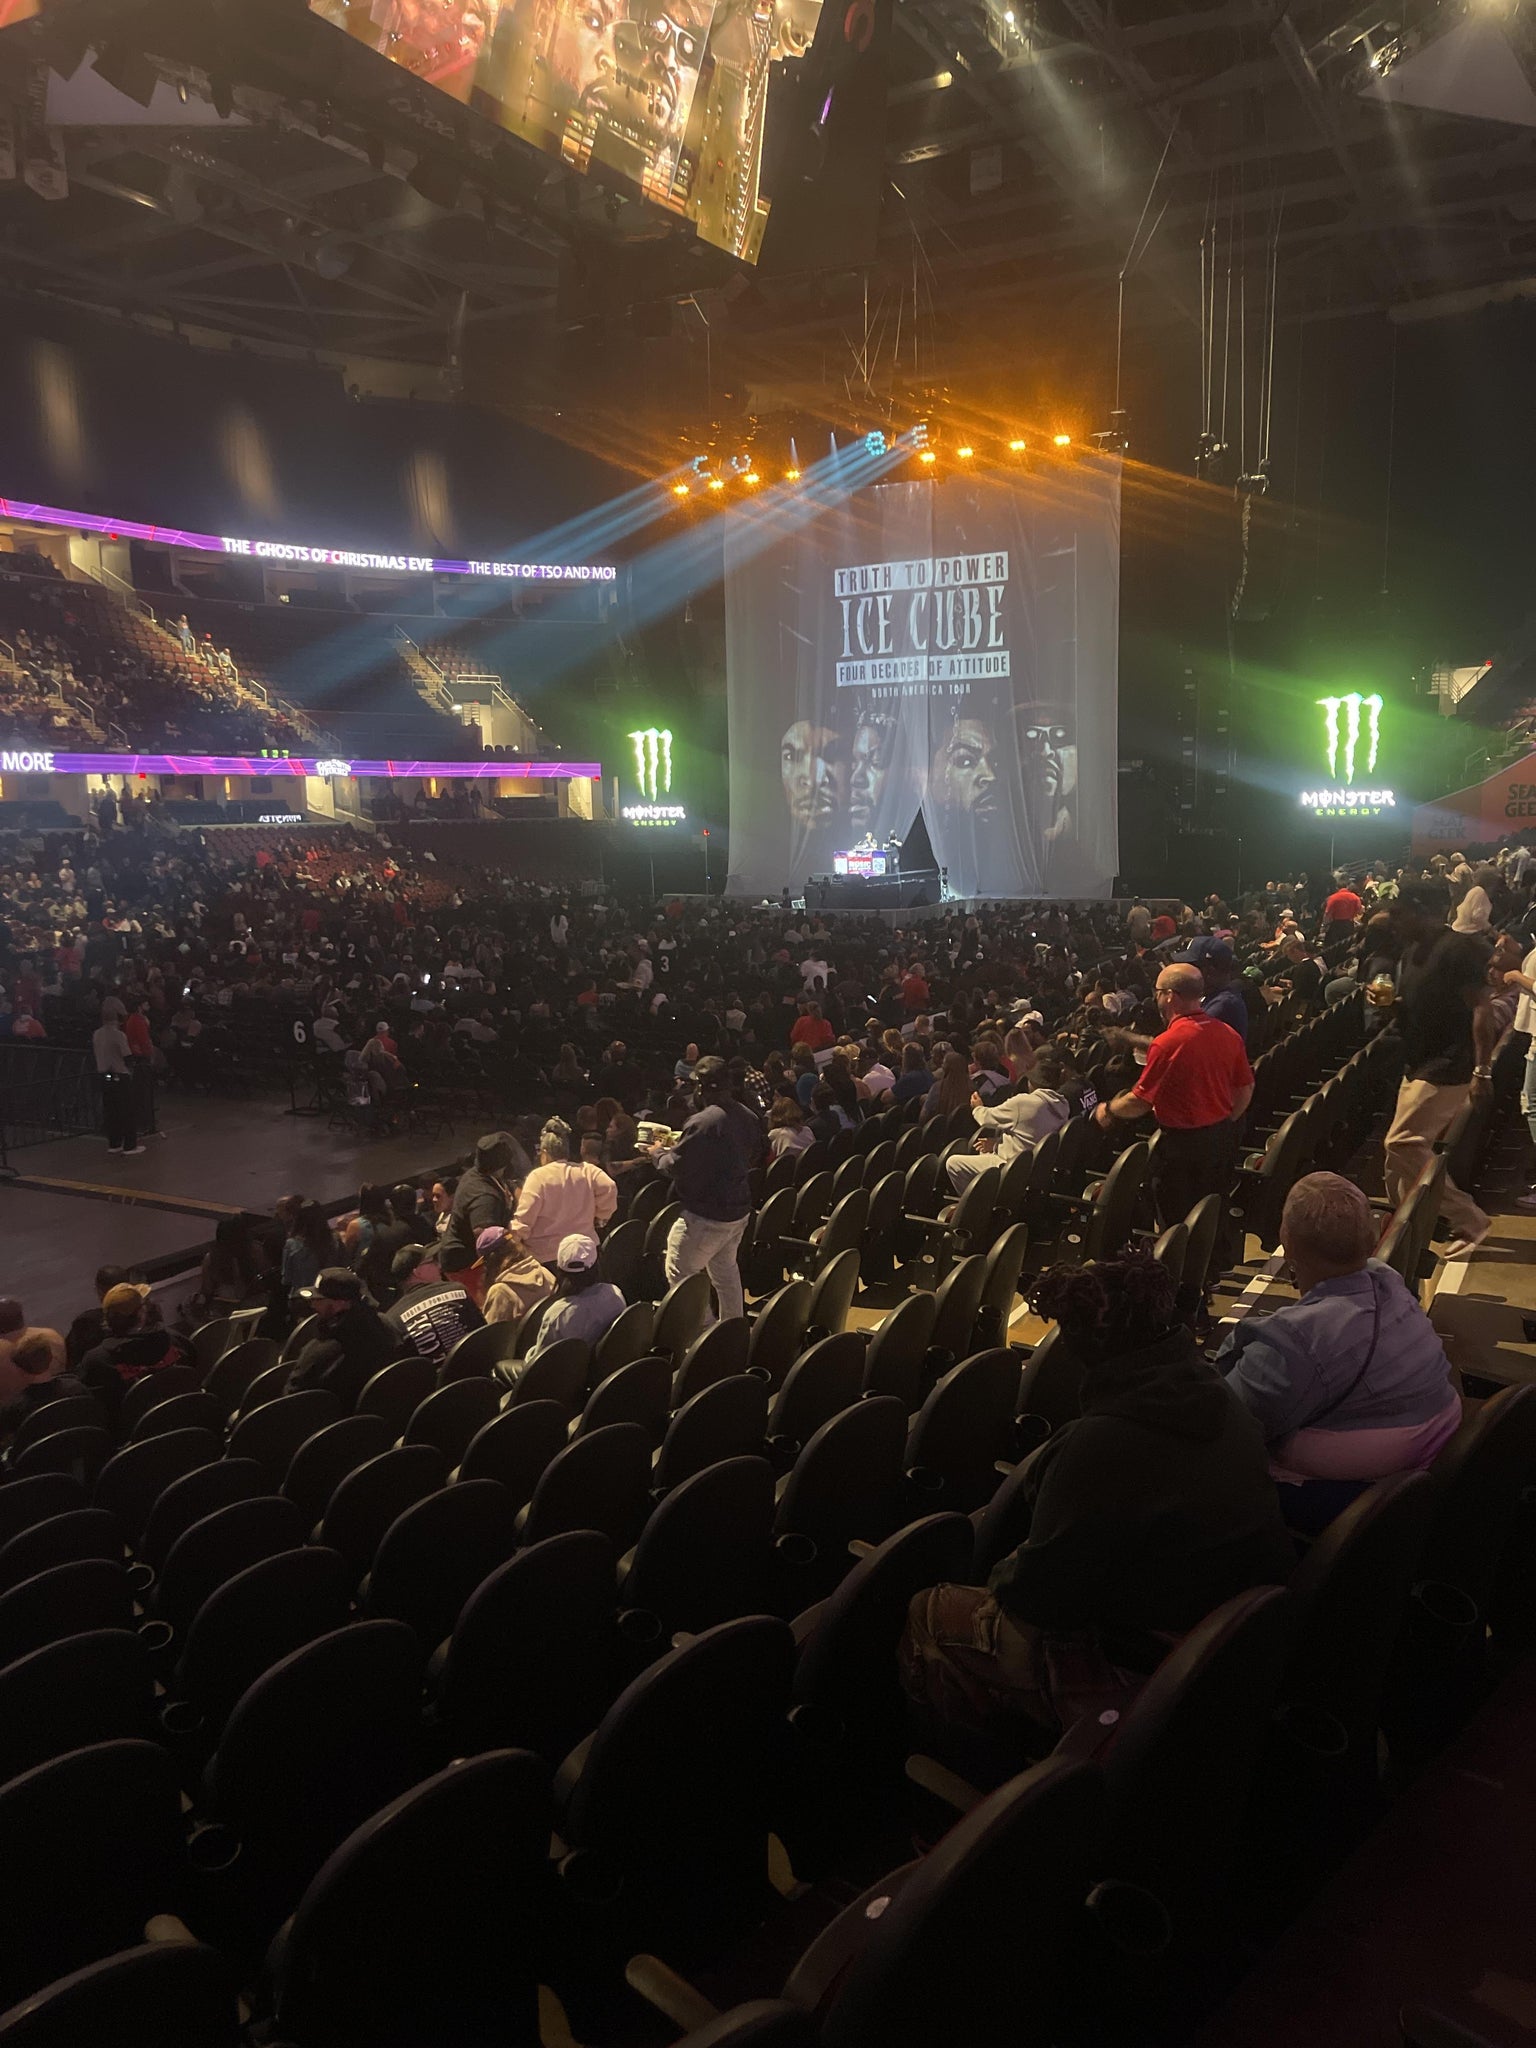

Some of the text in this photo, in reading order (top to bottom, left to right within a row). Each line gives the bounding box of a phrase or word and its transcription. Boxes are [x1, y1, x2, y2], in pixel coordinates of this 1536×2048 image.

[221, 537, 434, 571] THE GHOSTS OF CHRISTMAS EVE
[469, 561, 491, 575] THE
[493, 563, 520, 577] BEST
[521, 564, 537, 578] OF
[539, 565, 562, 579] TSO
[564, 566, 590, 579] AND
[838, 555, 1005, 593] TRUTH TO POWER
[840, 585, 1005, 657] ICE CUBE
[840, 656, 1007, 682] FOUR DECADES OF ATTITUDE
[871, 683, 971, 698] NORTH AMERICA TOUR
[2, 751, 56, 772] MORE
[1301, 790, 1396, 807] MONSTER
[622, 805, 686, 820] MONSTER
[1315, 807, 1381, 816] ENERGY
[347, 943, 356, 958] 2
[660, 955, 669, 972] 3
[293, 1021, 306, 1043] 6
[1080, 1090, 1097, 1108] VANS
